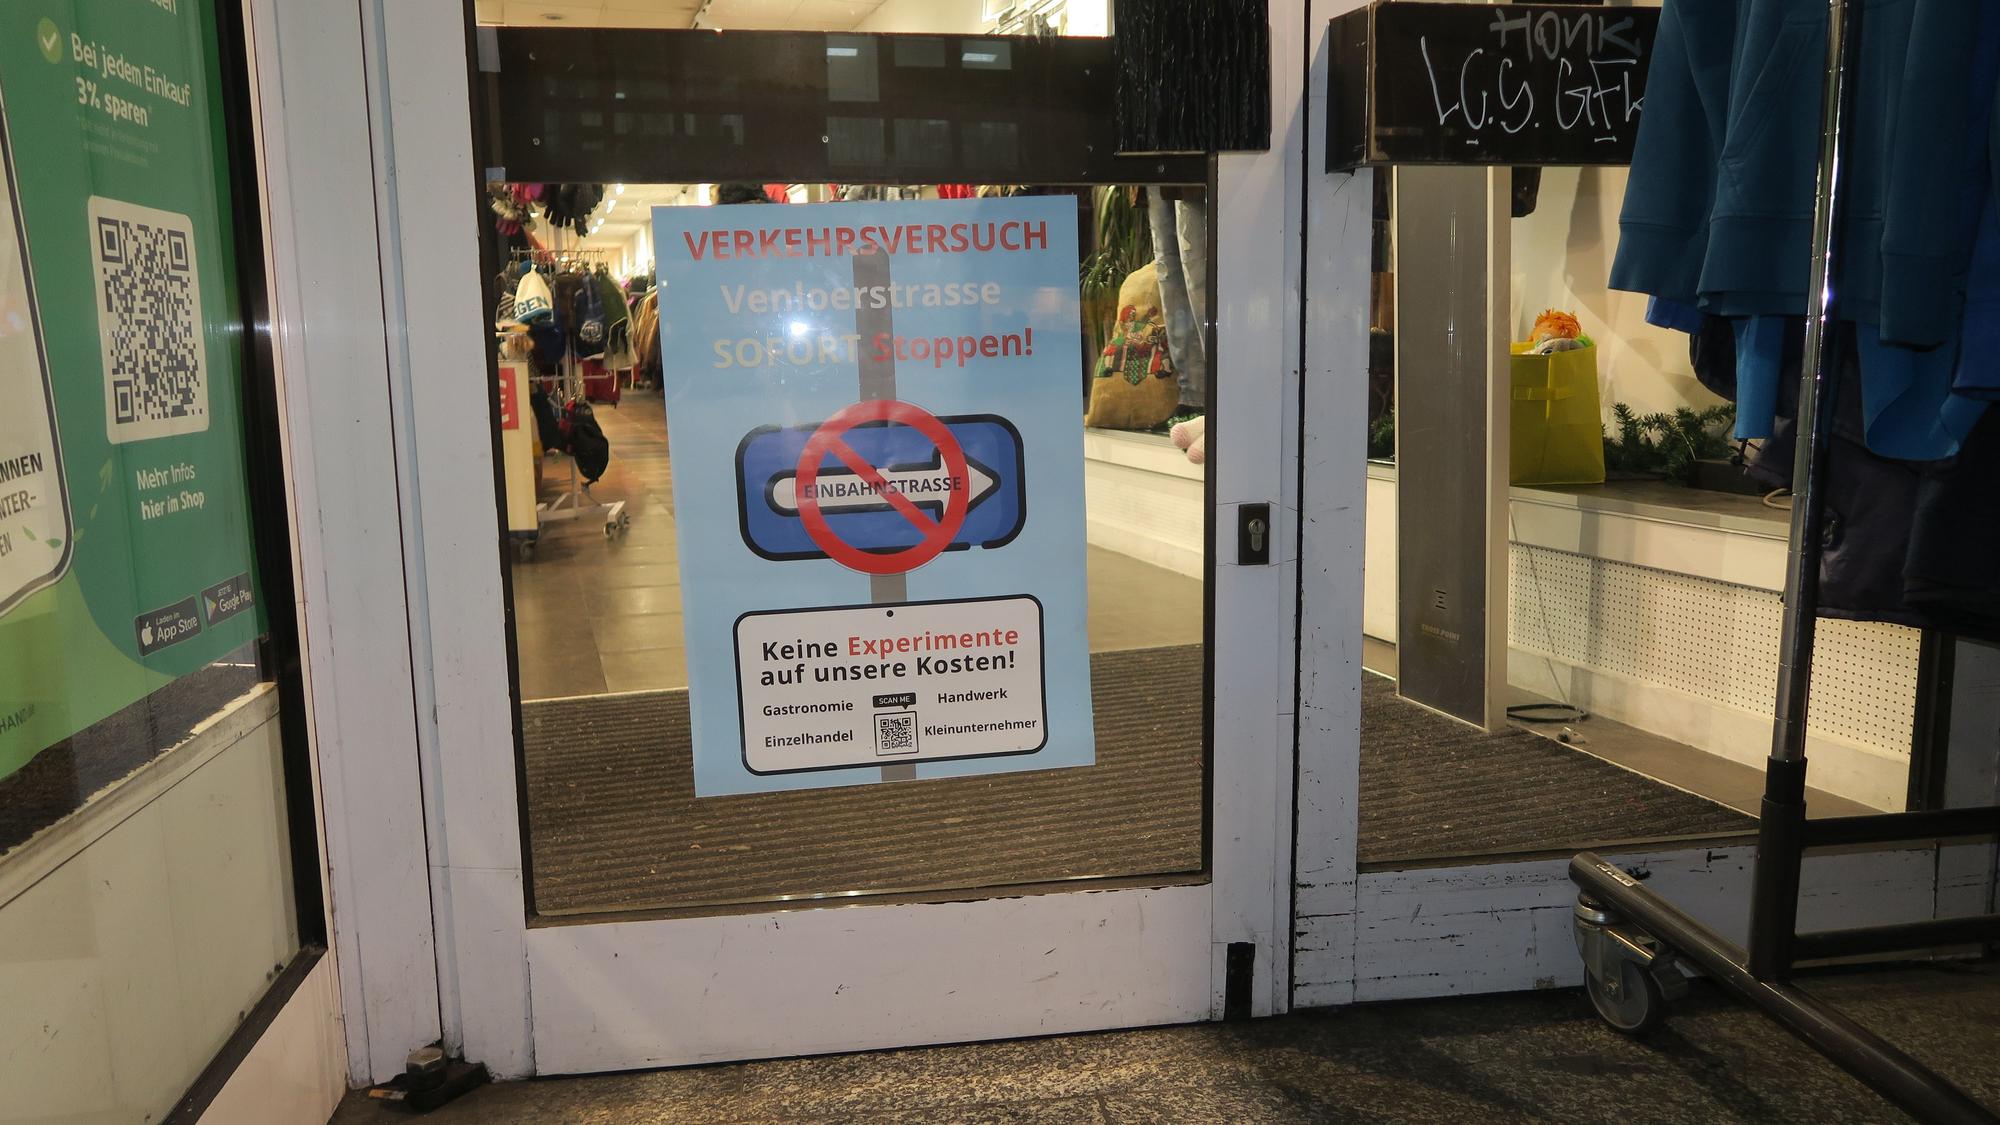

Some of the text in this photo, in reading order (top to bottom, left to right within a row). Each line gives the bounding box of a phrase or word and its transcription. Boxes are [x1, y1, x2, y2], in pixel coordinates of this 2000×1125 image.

[71, 32, 192, 107] Bei jedem Einkauf
[76, 76, 101, 110] 3%
[683, 220, 1049, 262] VERKEHRSVERSUCH
[720, 279, 1001, 315] Venloerstrasse
[713, 327, 1034, 370] SOFORT Stoppen!
[136, 462, 196, 491] Mehr Infos
[804, 476, 962, 499] EINBAHNSTRASSE
[141, 490, 205, 521] hier im Shop
[156, 616, 198, 642] App Store
[762, 627, 1019, 661] Keine Experimente
[760, 650, 1016, 686] auf unsere Kosten!
[762, 699, 854, 717] Gastronomie
[879, 695, 911, 705] SCAN ME
[937, 687, 1008, 704] Handwerk
[764, 729, 854, 748] Einzelhandel
[924, 717, 1038, 737] Kleinunternehmer
